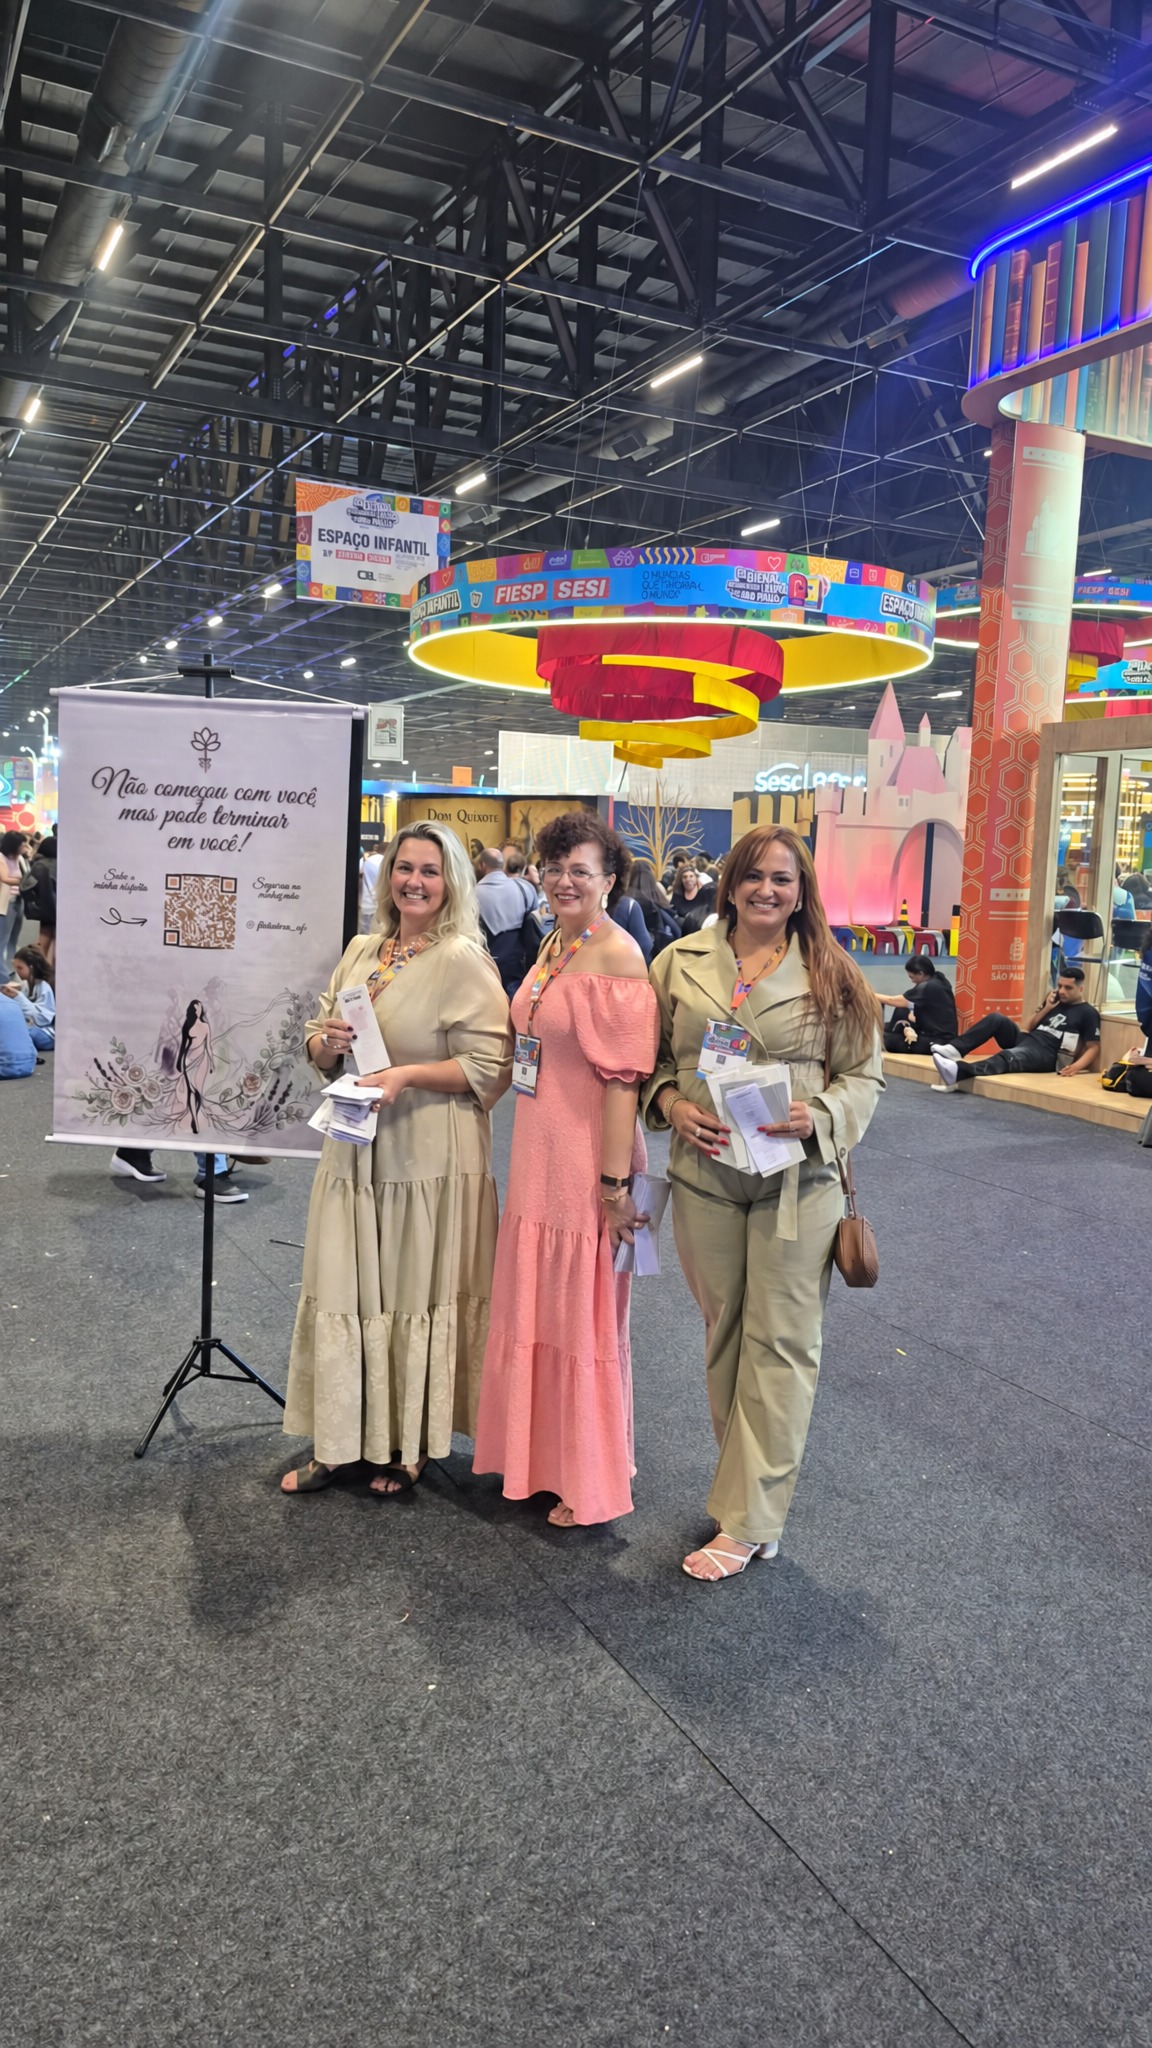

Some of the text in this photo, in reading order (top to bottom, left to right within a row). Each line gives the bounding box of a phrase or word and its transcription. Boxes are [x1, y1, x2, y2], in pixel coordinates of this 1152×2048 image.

[318, 528, 370, 550] ESPAÇO
[374, 535, 430, 556] INFANTIL
[427, 591, 459, 615] INFANTIL
[495, 580, 606, 603] FIESP SESI
[883, 594, 914, 619] ESPAÇO
[91, 766, 148, 798] Não
[154, 781, 229, 806] começou
[234, 786, 272, 803] com
[754, 767, 803, 792] Sesc
[118, 803, 290, 831] mas pode terminar
[167, 832, 252, 853] em você!
